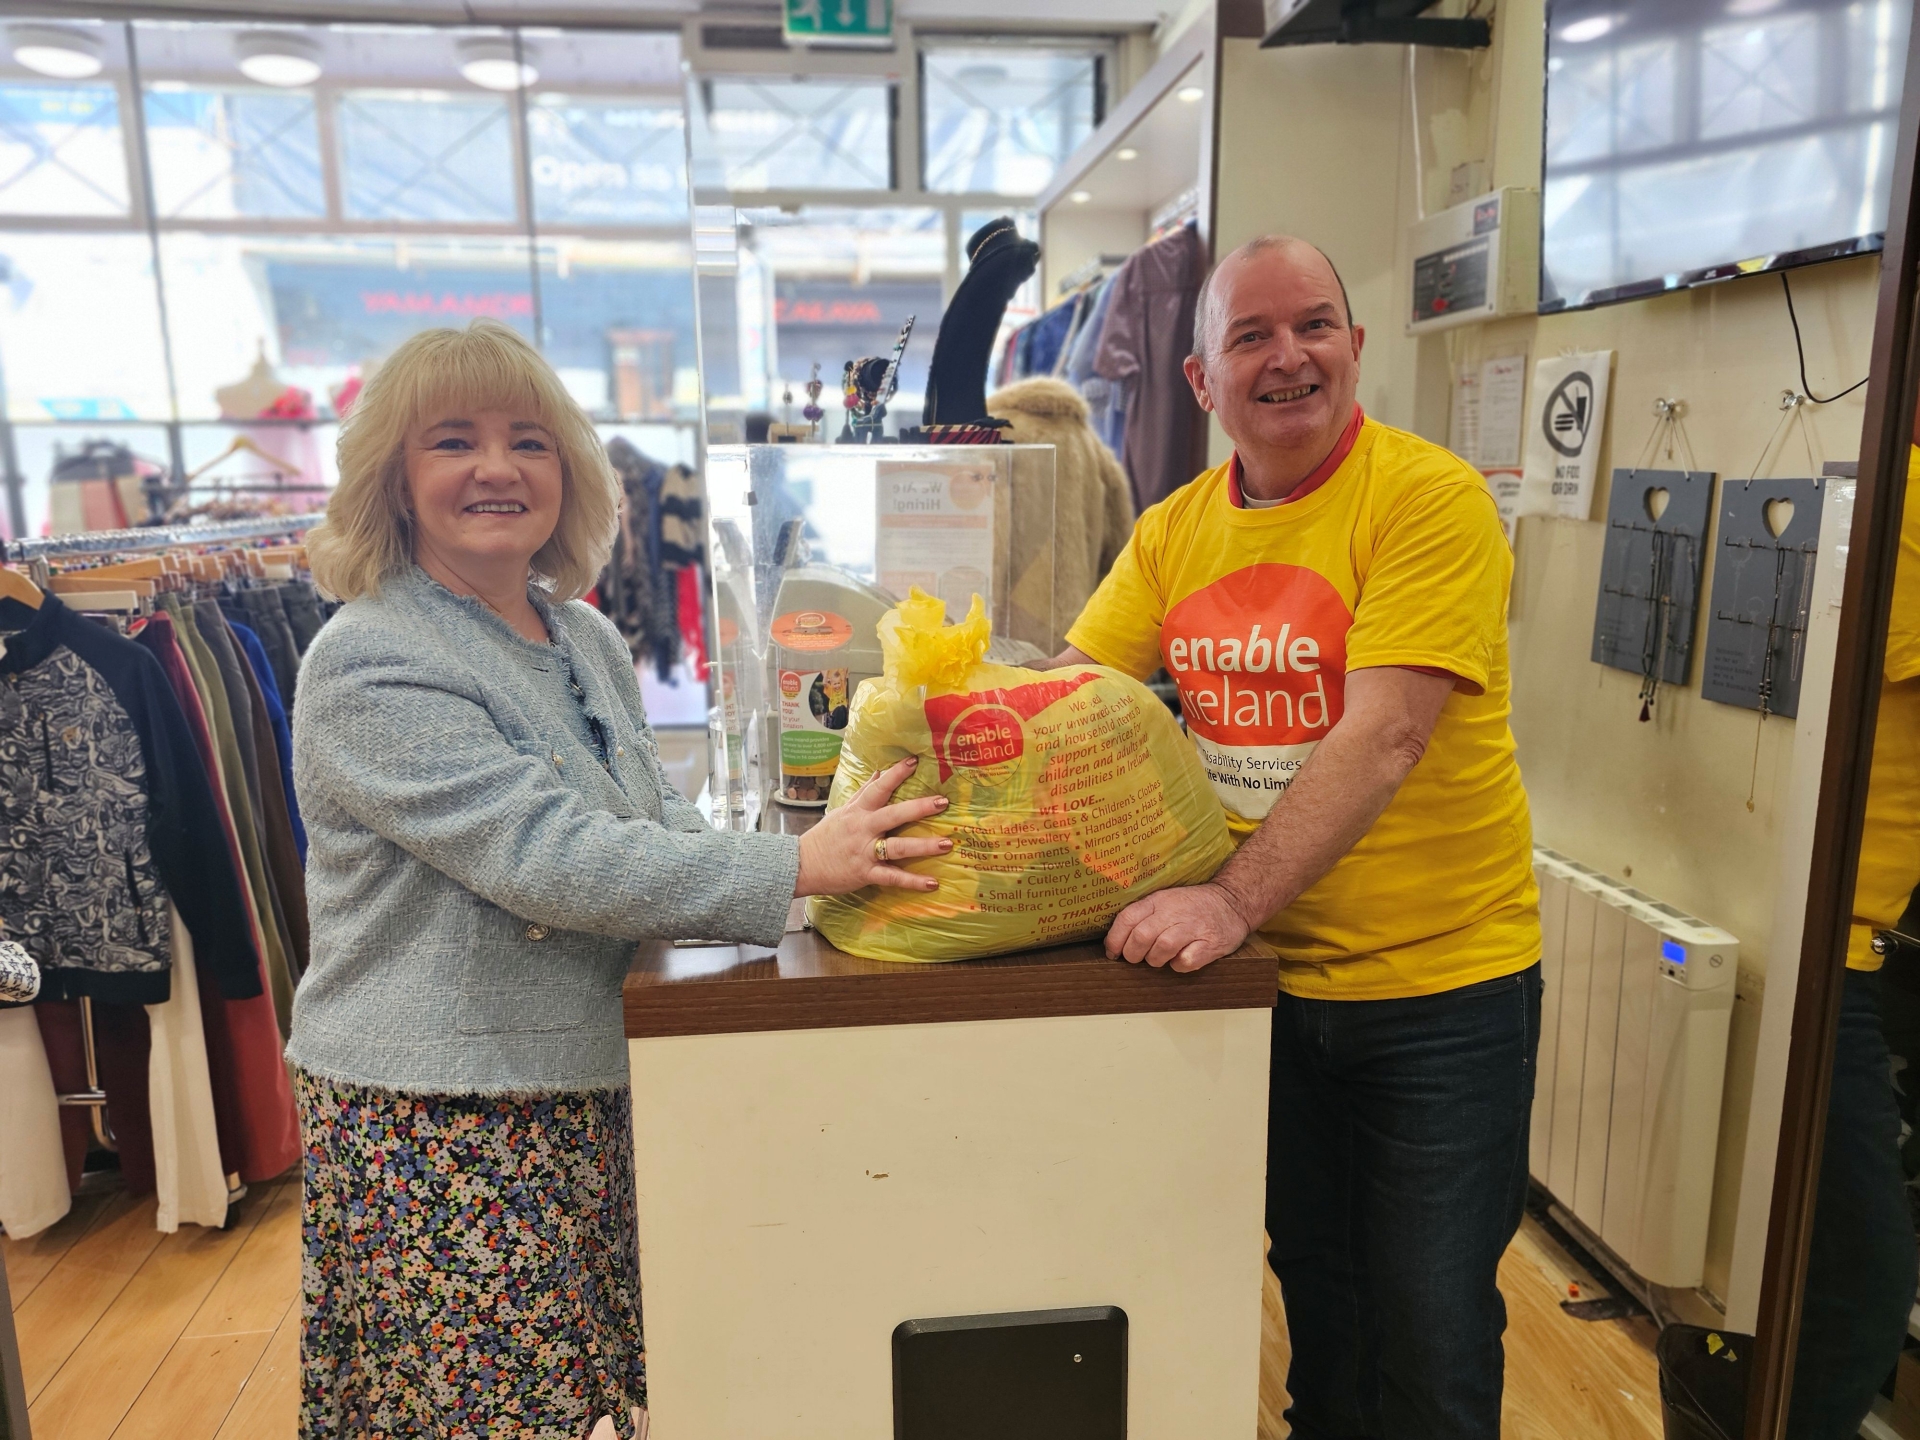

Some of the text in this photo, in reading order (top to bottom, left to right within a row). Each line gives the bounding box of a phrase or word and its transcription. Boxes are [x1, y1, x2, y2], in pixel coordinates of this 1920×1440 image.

[1169, 623, 1321, 673] enable
[1068, 701, 1087, 714] We
[1176, 674, 1330, 729] ireland
[956, 724, 1012, 747] enable
[1033, 723, 1062, 739] your
[1036, 736, 1060, 753] and
[1064, 718, 1116, 746] household
[1050, 744, 1097, 766] support
[1100, 728, 1134, 752] services
[959, 739, 1015, 762] ireland
[1038, 763, 1090, 784] children
[1093, 752, 1113, 769] and
[1116, 741, 1139, 761] adults
[1247, 757, 1302, 771] Services
[1050, 747, 1152, 797] disabilities in Ireland.
[1205, 767, 1217, 782] ife
[1218, 771, 1240, 787] With
[1242, 776, 1260, 789] No
[963, 825, 996, 835] Clean
[1043, 816, 1077, 830] Gents
[1080, 812, 1089, 823] &
[1091, 794, 1136, 819] Children's
[1137, 779, 1161, 799] Clothes
[966, 792, 1164, 849] Shoes Jewellery Handbags Hats &
[1040, 795, 1105, 816] WE LOVE...
[960, 807, 1164, 861] Belts Ornaments Mirrors and Clocks
[974, 821, 1166, 872] Curtains Towels & Linen Crockery
[989, 852, 1160, 900] Small furniture Unwanted Gifts
[1027, 852, 1135, 885] Cutlery & Glassware
[980, 862, 1166, 912] Bric-a-Brac Collectibles & Antiques
[1038, 901, 1120, 925] NO THANKS...
[1040, 916, 1090, 934] Electrical
[1045, 928, 1082, 941] Broken
[1086, 922, 1110, 931] Item
